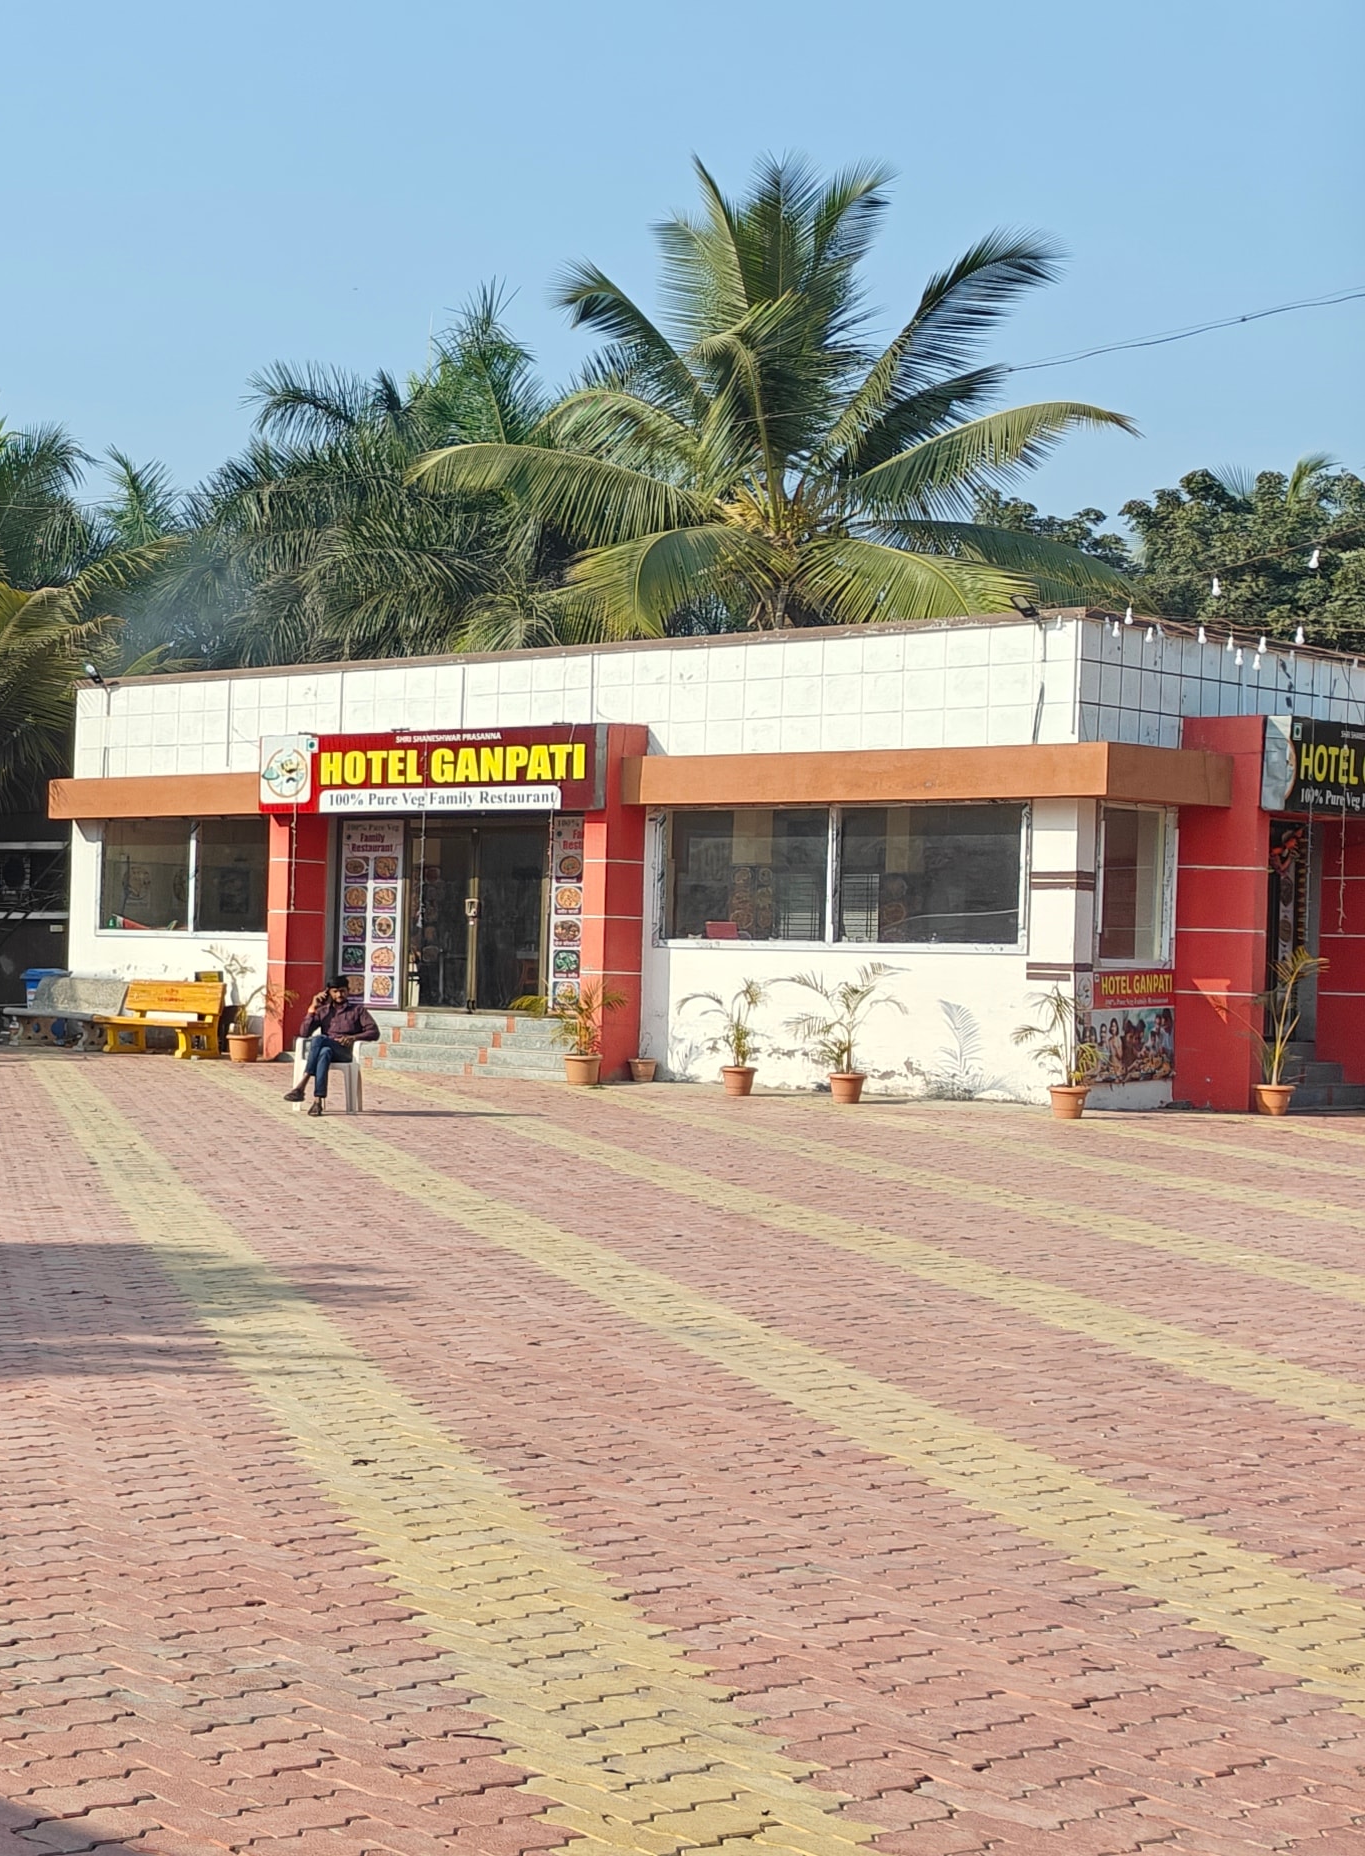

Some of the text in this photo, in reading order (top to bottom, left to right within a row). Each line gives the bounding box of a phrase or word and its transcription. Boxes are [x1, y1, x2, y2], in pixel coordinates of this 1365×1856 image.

[395, 735, 412, 743] SHRI
[462, 732, 502, 742] PRASANNA
[320, 743, 586, 785] HOTEL GANPATI
[1300, 742, 1359, 785] HOTEL
[329, 790, 558, 808] 100% Pure Veg Family Restaurant
[1300, 788, 1324, 805] 100%
[1325, 789, 1345, 806] Pure
[1346, 791, 1362, 812] Veg
[351, 843, 393, 852] Restaurant
[360, 833, 385, 843] Family
[1101, 974, 1173, 995] HOTEL GANPATI
